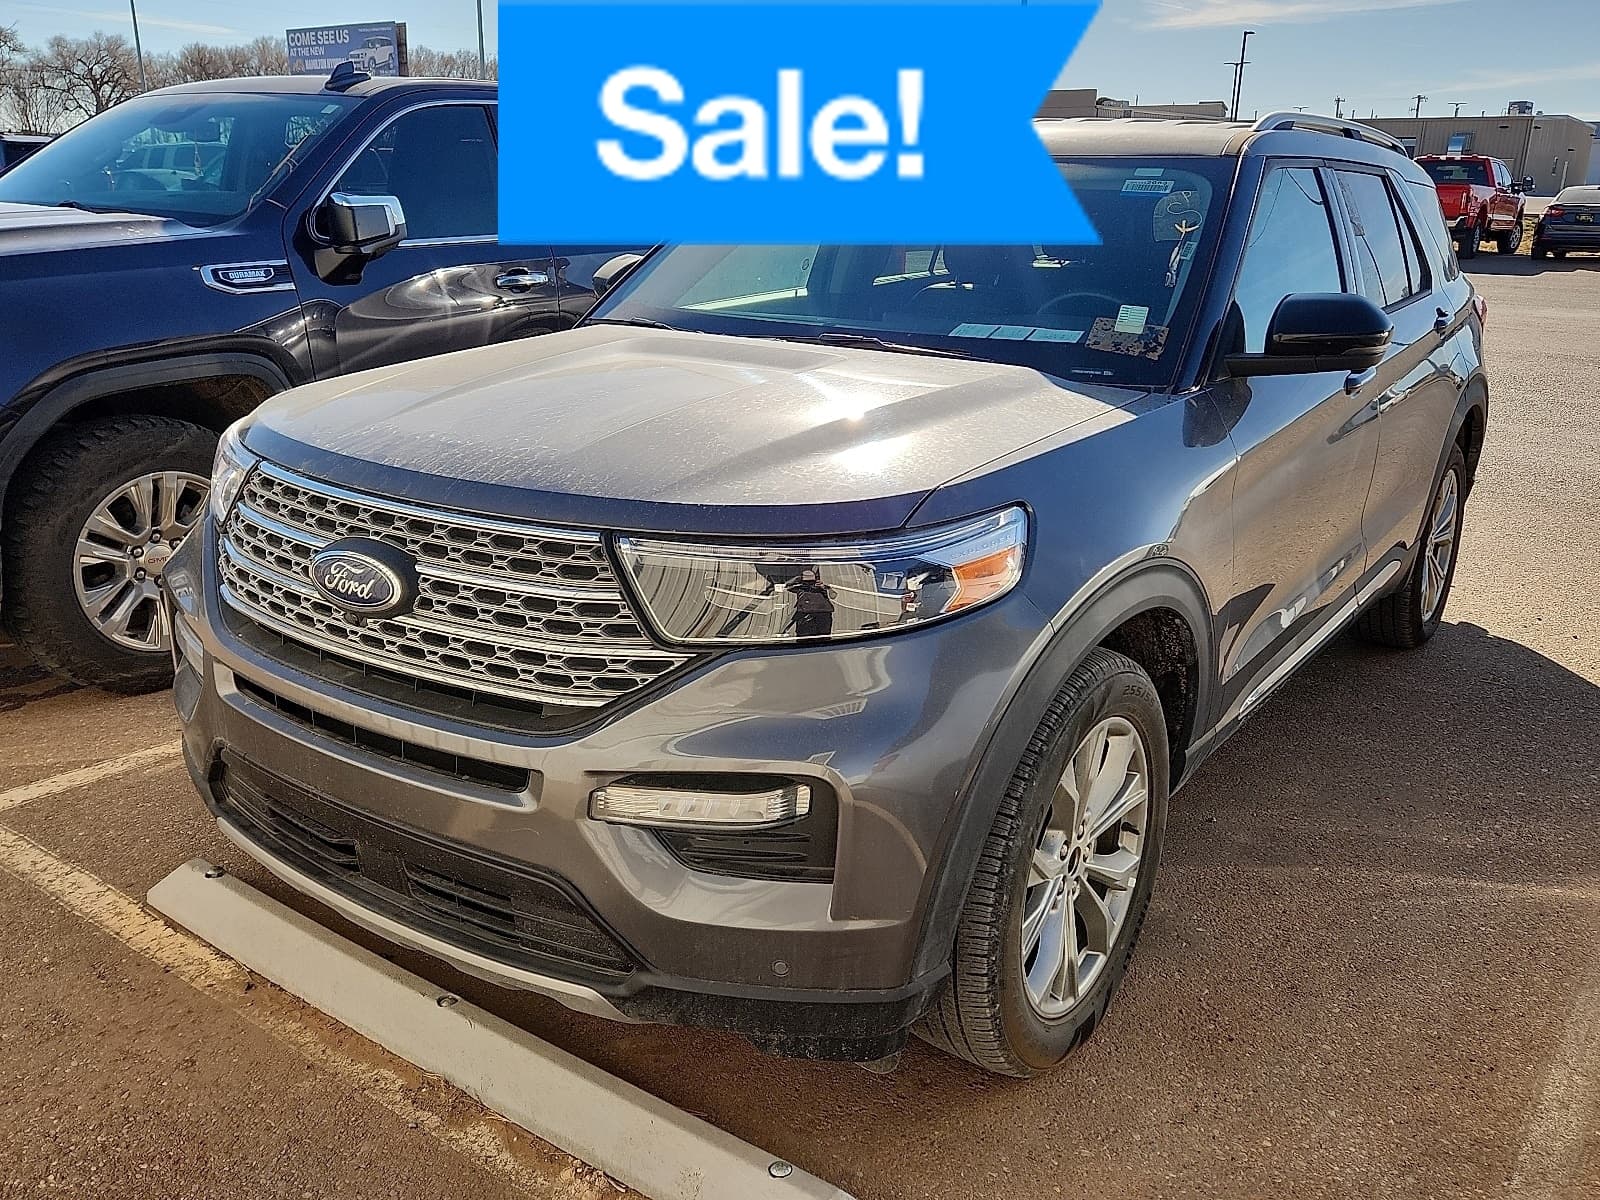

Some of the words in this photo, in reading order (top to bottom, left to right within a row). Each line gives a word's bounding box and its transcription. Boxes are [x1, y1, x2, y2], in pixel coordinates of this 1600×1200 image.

[288, 31, 317, 47] COME
[317, 30, 335, 45] SEE
[336, 29, 350, 44] US
[289, 47, 297, 57] AT
[297, 46, 310, 57] THE
[310, 45, 325, 56] NEW
[228, 270, 266, 279] DURAMAX
[324, 561, 375, 600] Ford
